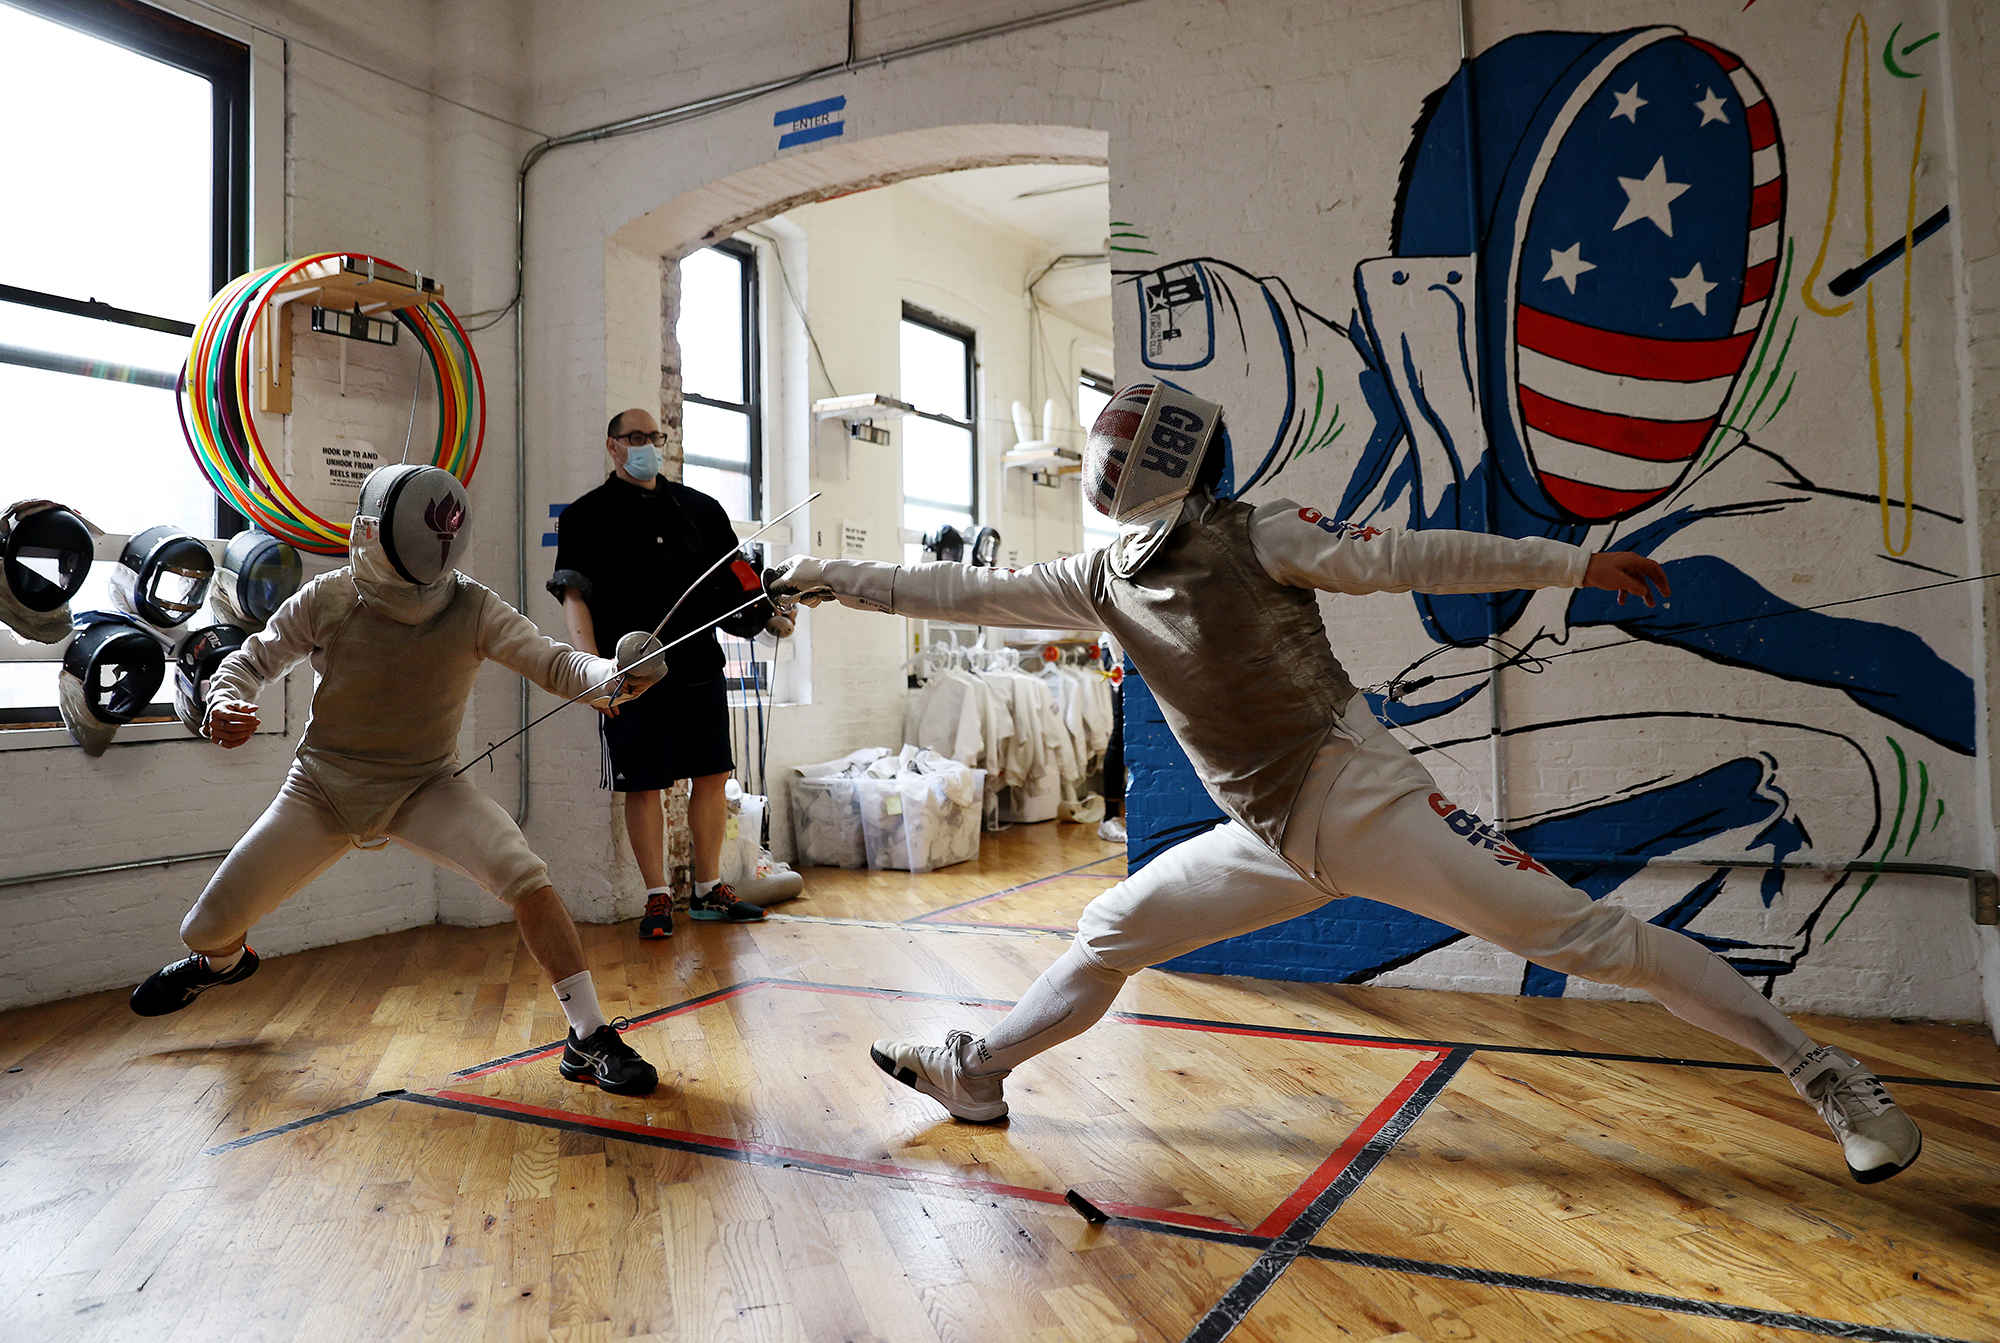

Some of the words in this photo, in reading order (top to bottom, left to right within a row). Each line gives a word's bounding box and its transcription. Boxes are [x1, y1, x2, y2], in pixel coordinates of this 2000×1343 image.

[793, 113, 830, 132] ENTER
[1141, 405, 1204, 479] GBR
[322, 446, 341, 456] HOOK
[342, 449, 352, 457] UP
[353, 450, 361, 459] TO
[362, 451, 379, 460] AND
[326, 458, 353, 468] UNHOOK
[354, 461, 374, 470] FROM
[330, 469, 350, 478] REELS
[1428, 792, 1506, 850] GBR
[975, 1038, 993, 1061] Paul
[1790, 1060, 1809, 1079] eon
[1805, 1046, 1824, 1061] Pau
